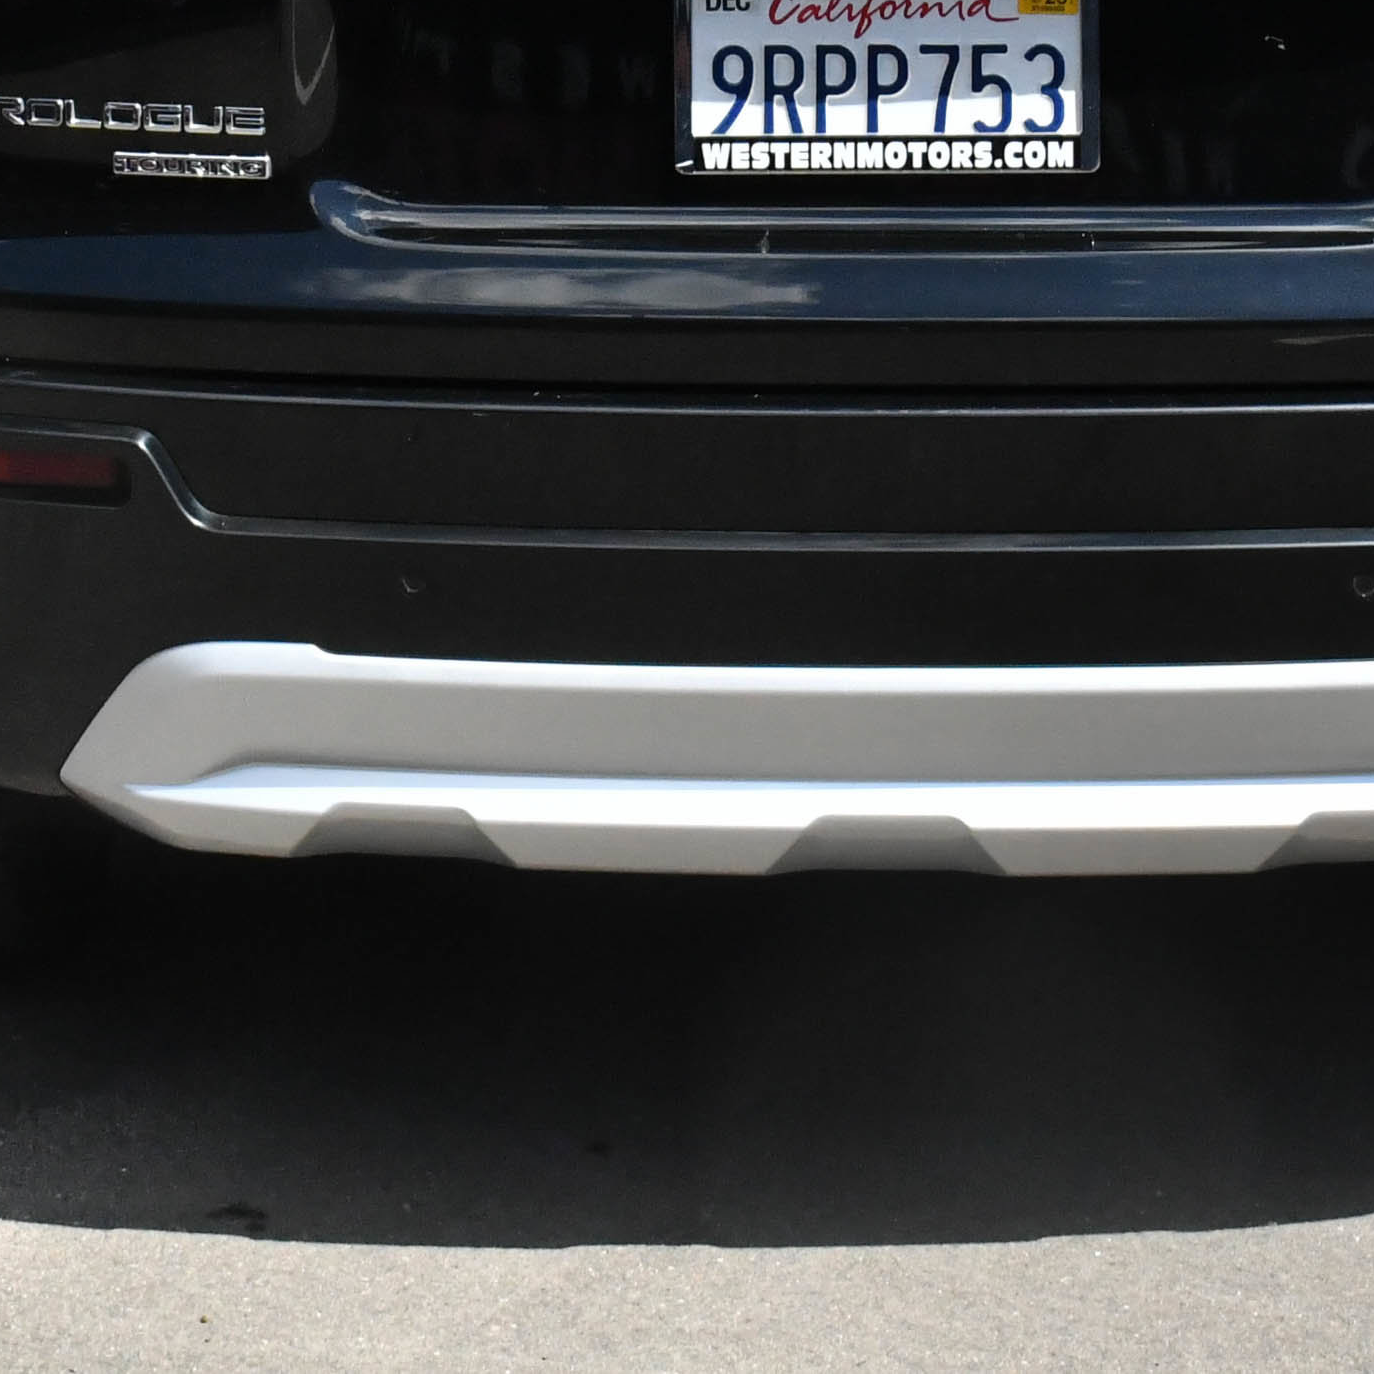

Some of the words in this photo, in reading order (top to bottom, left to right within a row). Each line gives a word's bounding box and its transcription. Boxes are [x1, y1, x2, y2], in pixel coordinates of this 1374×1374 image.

[711, 43, 1066, 135] 9RPP753
[117, 152, 267, 178] TOURING
[701, 140, 1074, 170] WESTERNMOTORS.COM
